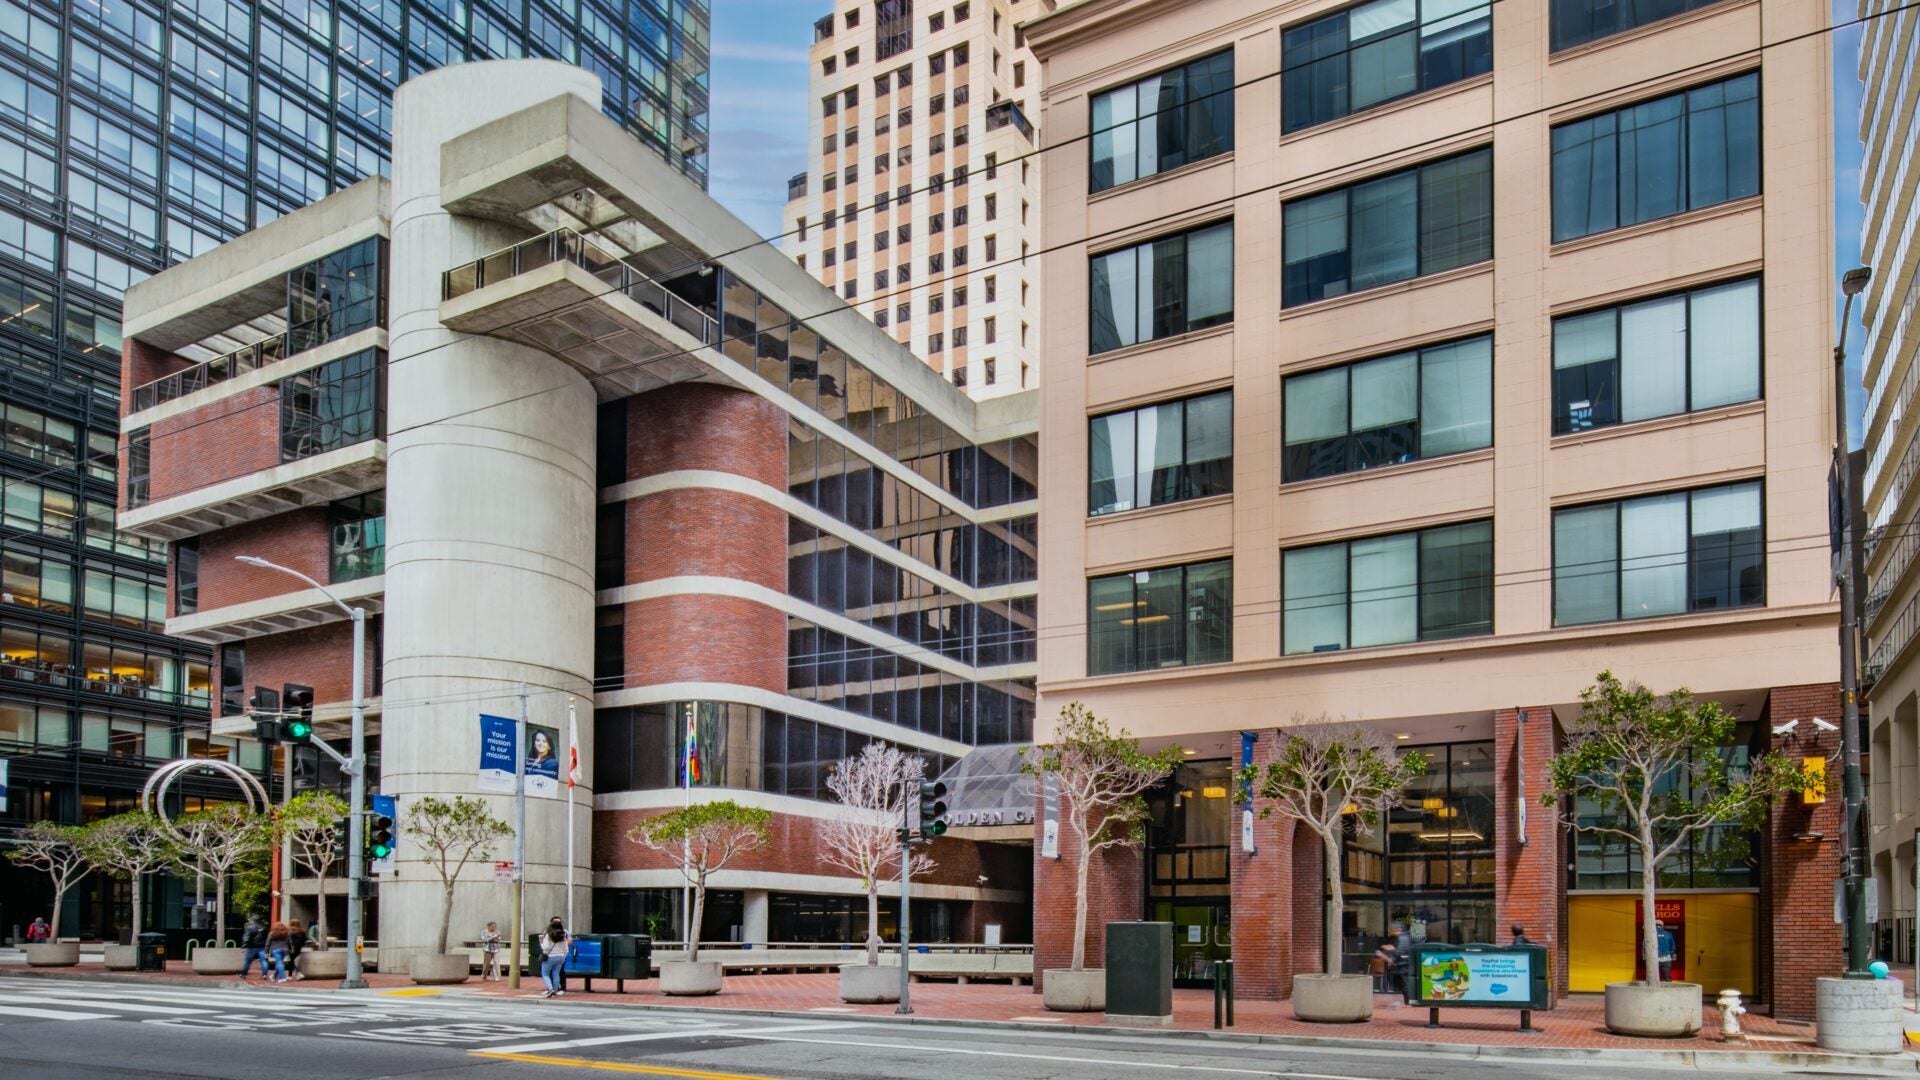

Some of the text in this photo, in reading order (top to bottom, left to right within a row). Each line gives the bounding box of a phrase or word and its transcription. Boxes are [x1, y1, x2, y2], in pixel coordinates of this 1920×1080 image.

[491, 730, 507, 739] Your
[487, 737, 511, 747] mission
[486, 752, 512, 761] mission.
[943, 808, 1034, 826] OLDEN GA
[317, 1023, 567, 1045] KEEP
